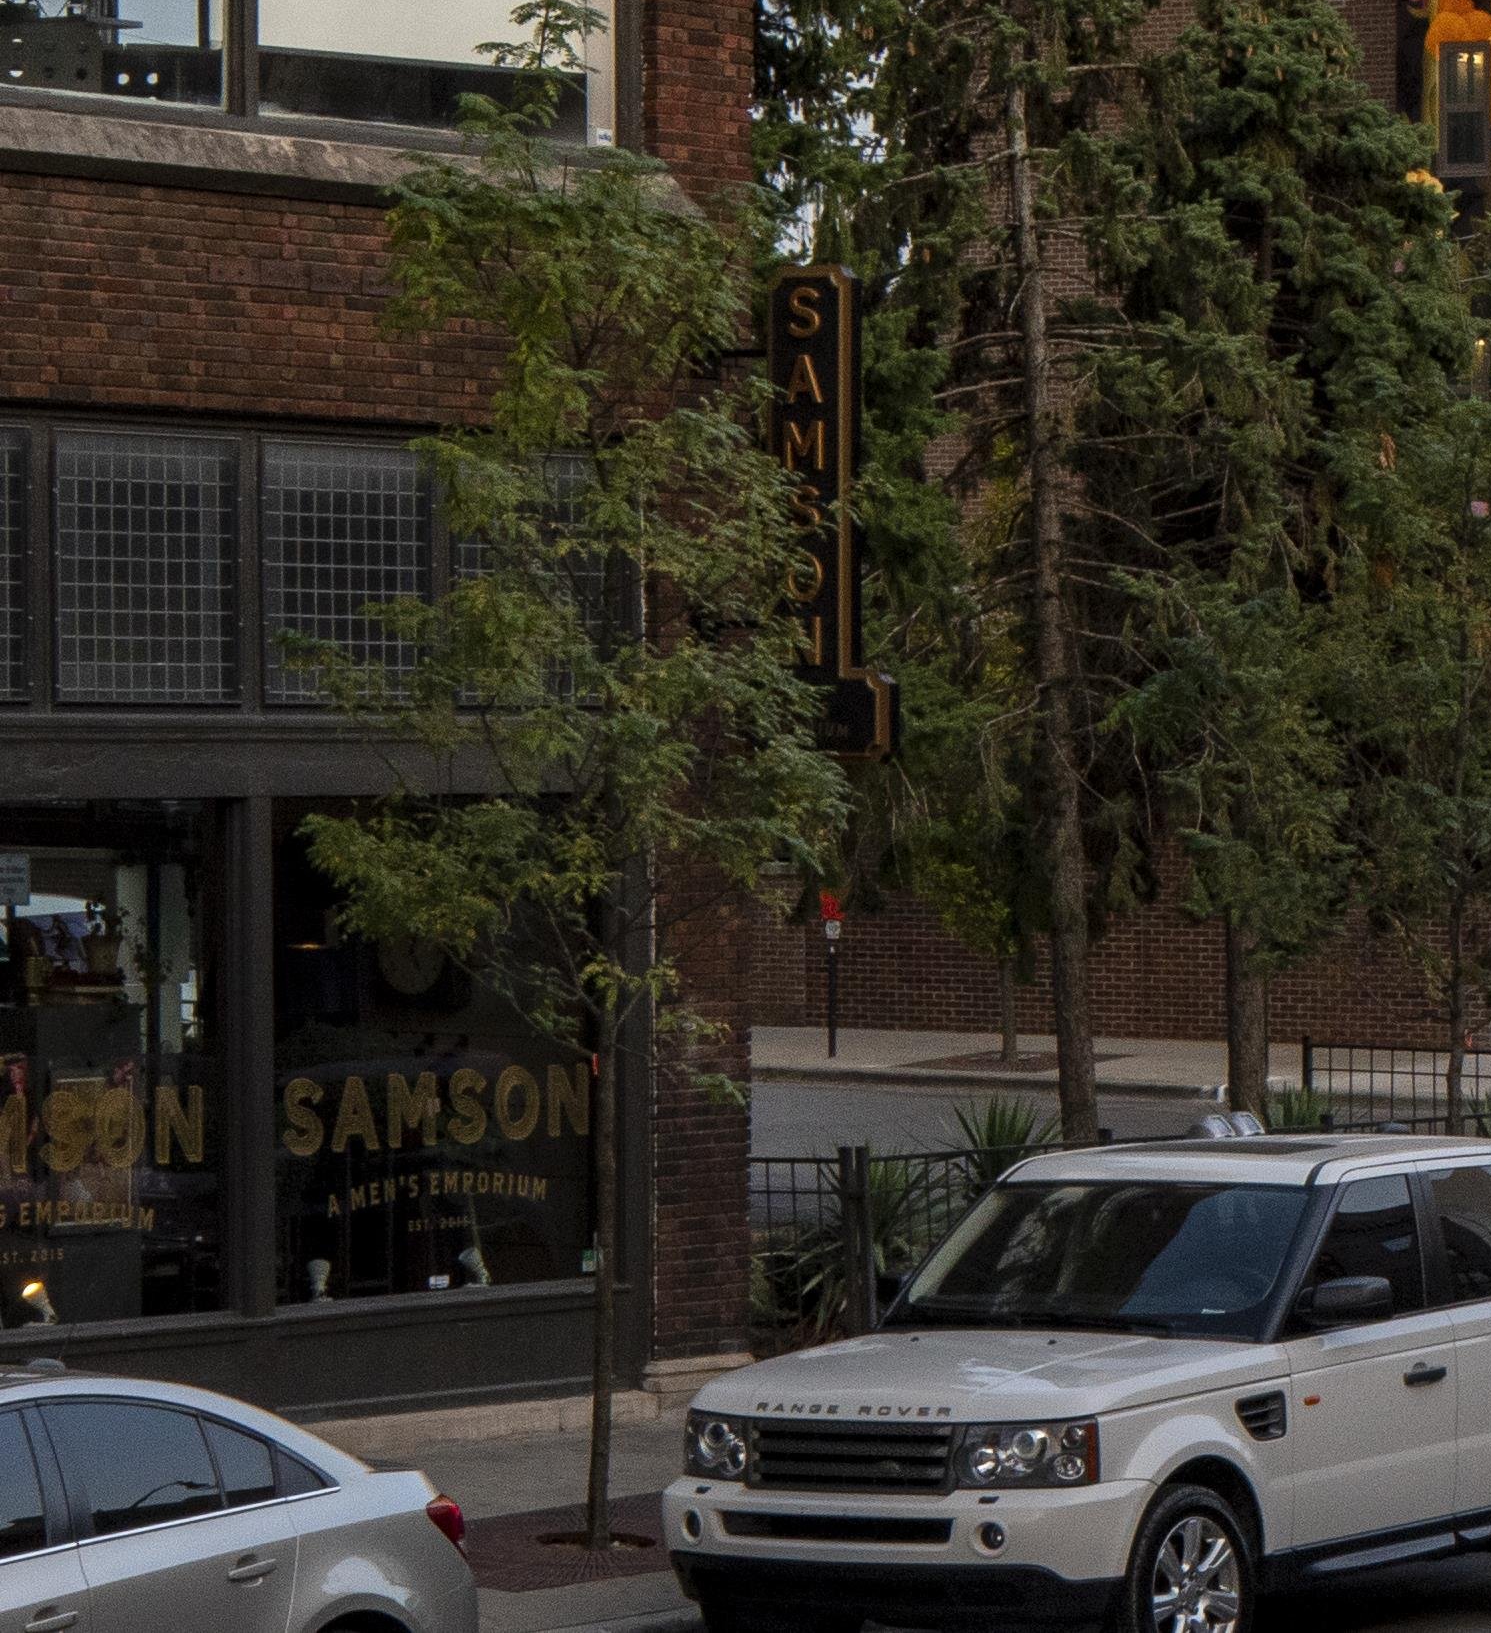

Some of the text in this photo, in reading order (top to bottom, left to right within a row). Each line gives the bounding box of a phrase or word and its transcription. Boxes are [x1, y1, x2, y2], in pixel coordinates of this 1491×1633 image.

[282, 1061, 590, 1156] SAMSON
[328, 1170, 548, 1218] A MEN'S EMPORIUM
[19, 1200, 155, 1230] EMPORIUM
[407, 1218, 434, 1233] EST.
[756, 1401, 953, 1417] RANGE ROVER
